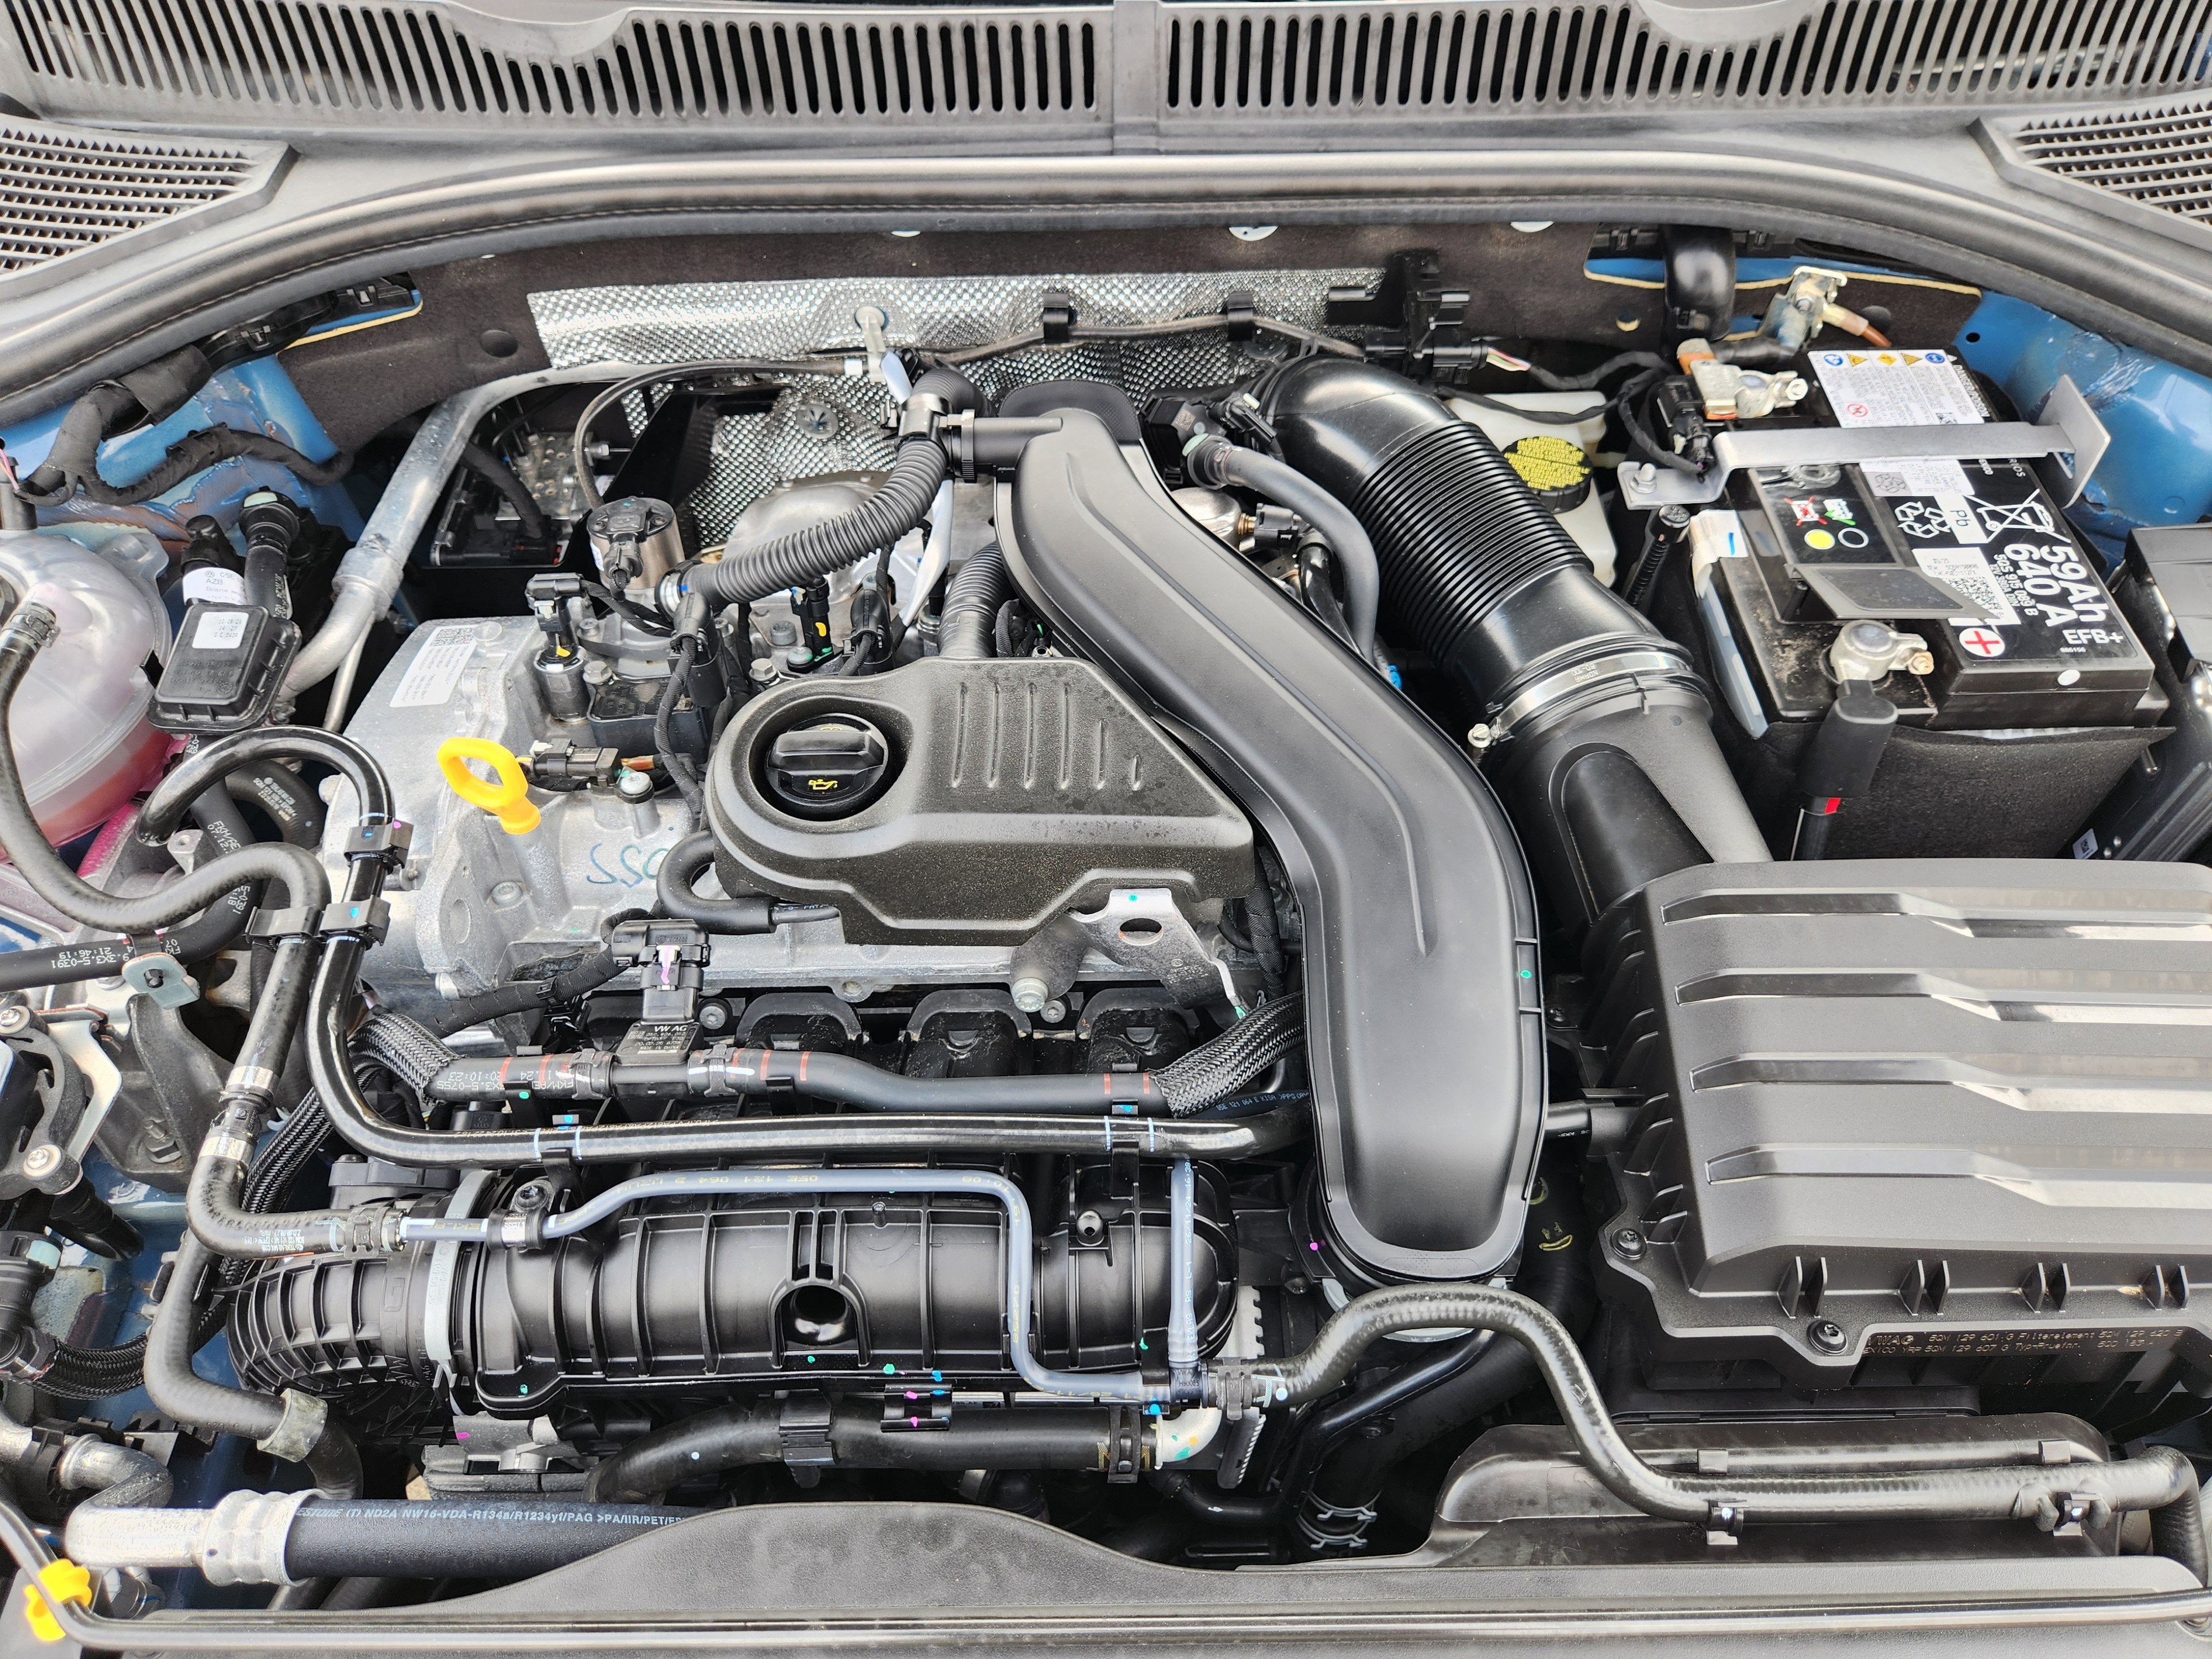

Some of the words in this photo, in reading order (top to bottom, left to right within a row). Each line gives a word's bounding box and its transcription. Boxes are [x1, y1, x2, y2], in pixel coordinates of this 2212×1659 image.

[2004, 543, 2062, 596] 640
[2036, 603, 2079, 627] A
[2039, 545, 2110, 623] 59Ah
[2024, 608, 2039, 616] B
[2062, 628, 2124, 645] EFB+
[1573, 670, 1599, 682] NORMA
[59, 946, 112, 960] 21:46:19
[743, 1175, 774, 1183] 121
[1957, 1333, 1976, 1342] 129
[2017, 1332, 2095, 1340] Filterelement
[1951, 1344, 1971, 1353] 129
[364, 1508, 398, 1518] ND2A
